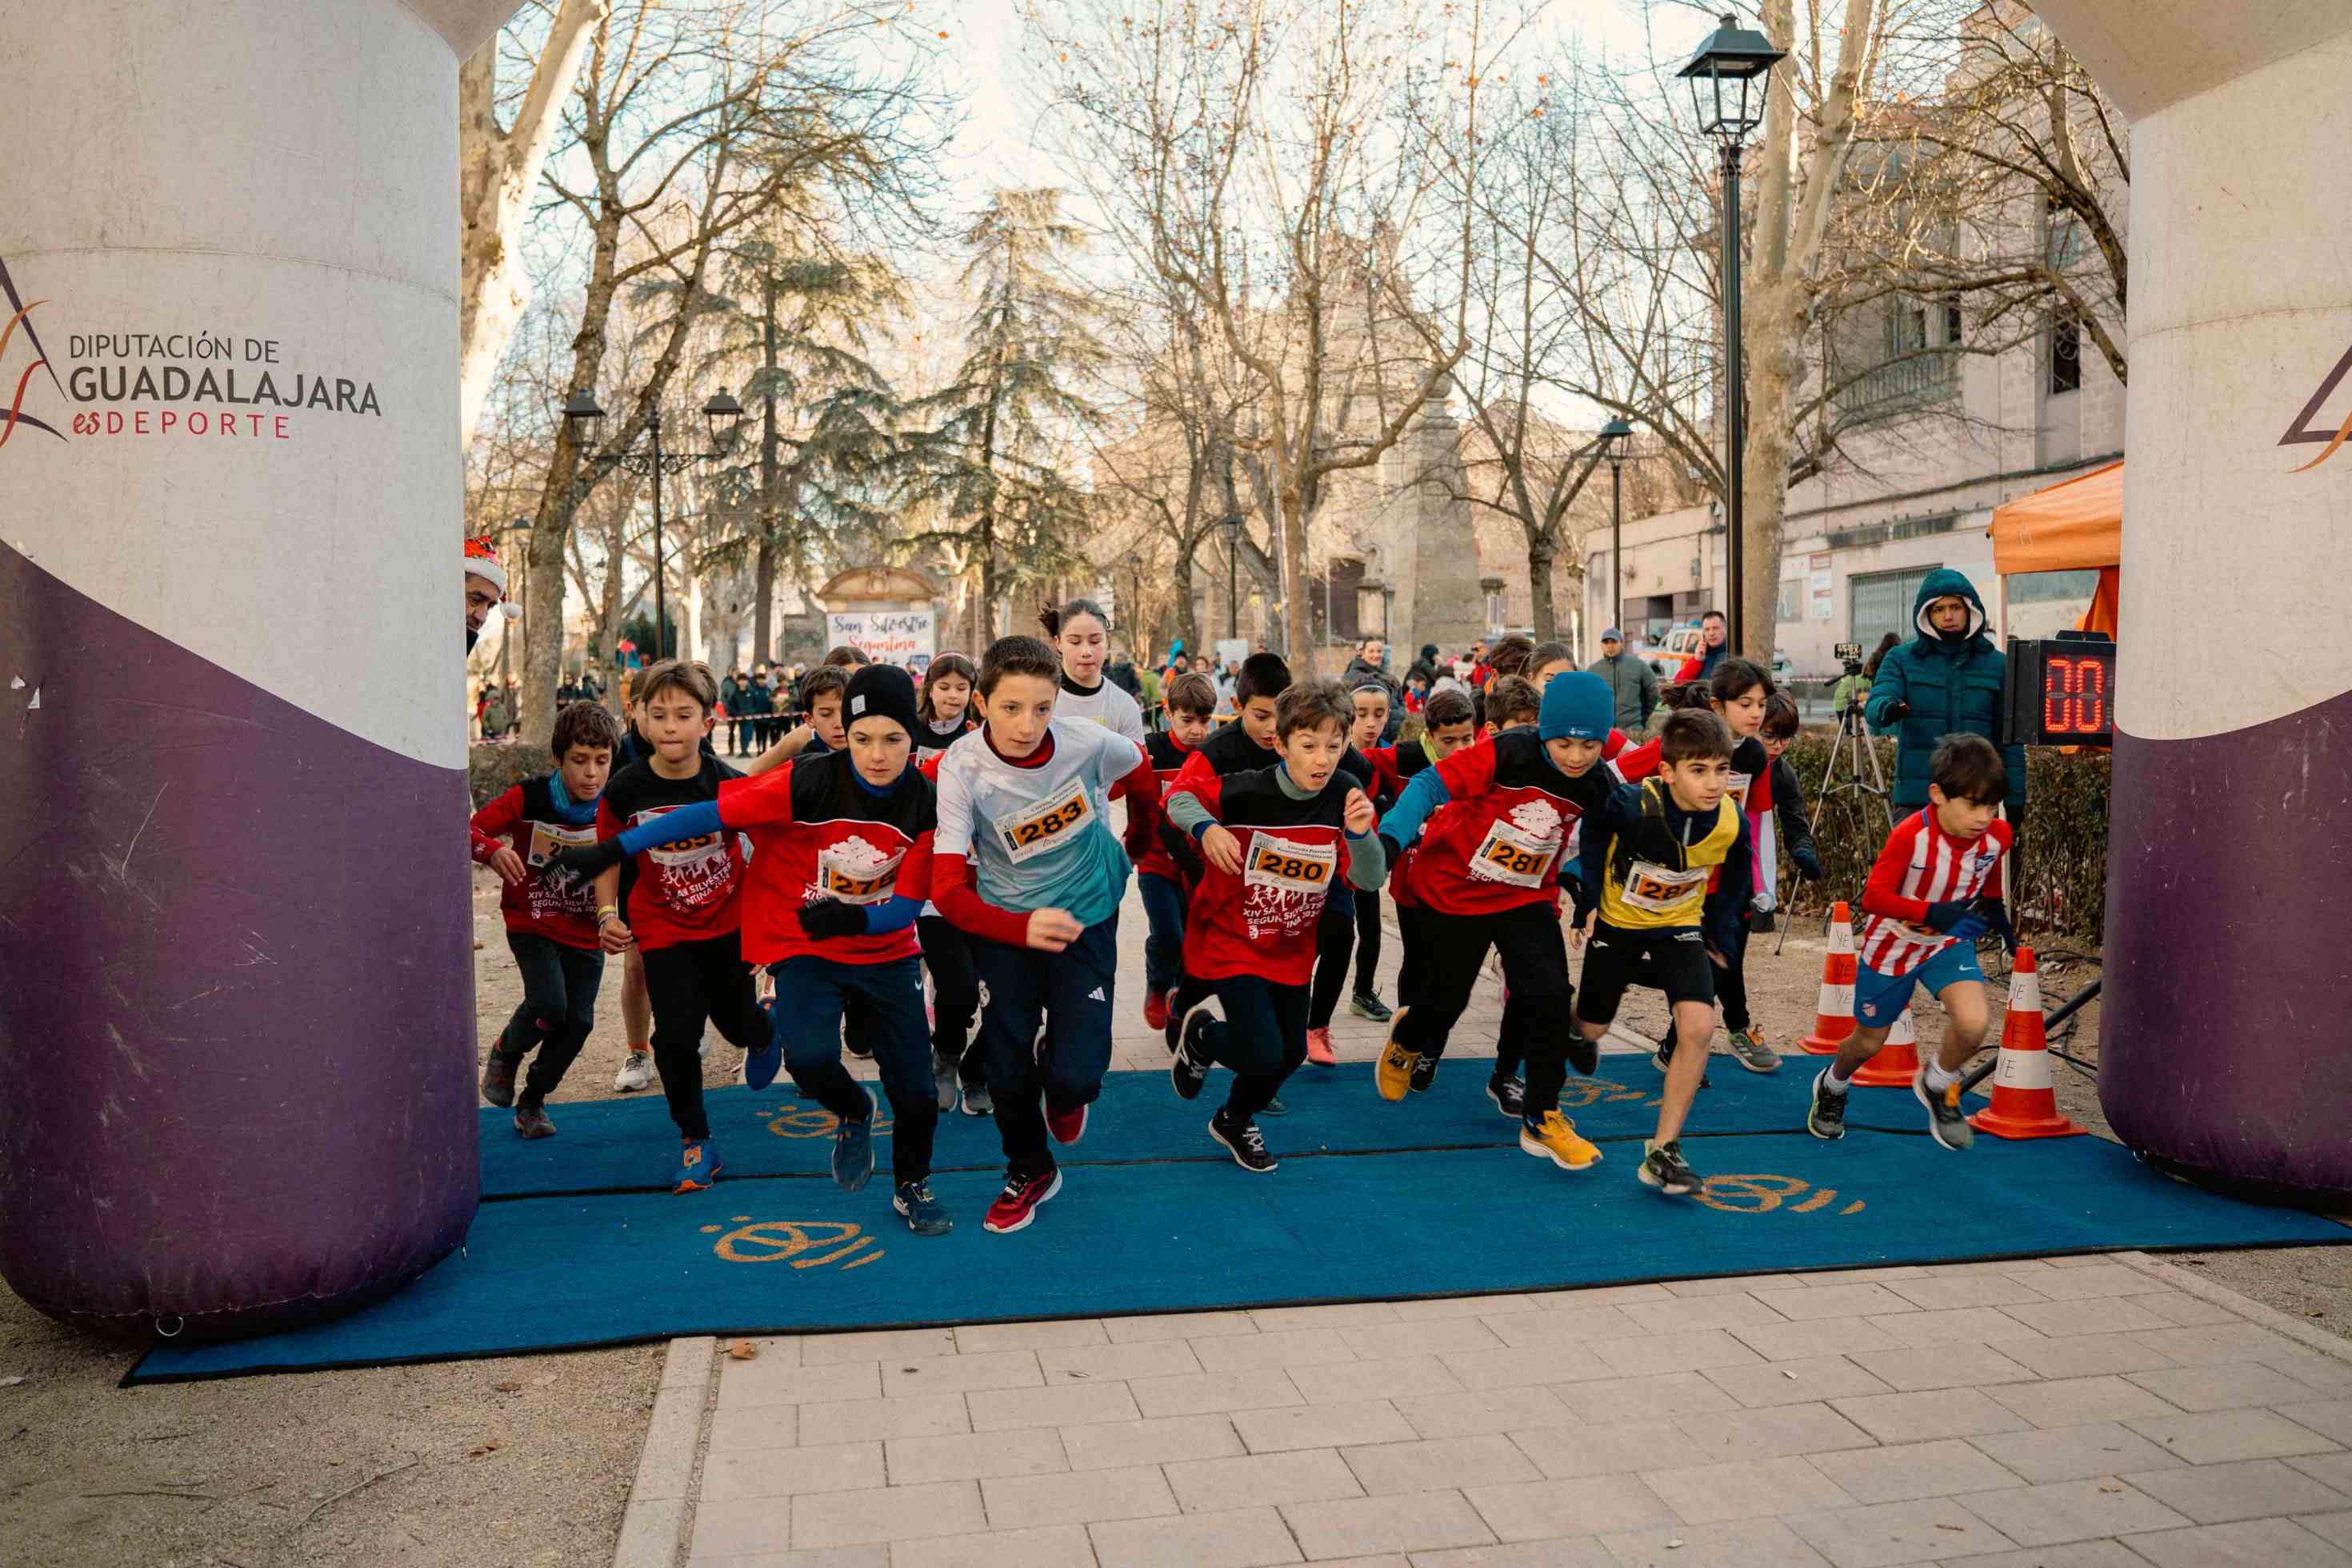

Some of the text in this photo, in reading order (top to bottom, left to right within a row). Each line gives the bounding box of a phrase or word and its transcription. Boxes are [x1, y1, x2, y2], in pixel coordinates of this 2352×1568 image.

[70, 330, 280, 363] DIPUTACIÓN DE
[70, 366, 382, 417] GUADALAJARA
[834, 614, 928, 634] San Silvestre
[1020, 801, 1082, 843] 283
[1262, 854, 1323, 880] 280
[1493, 845, 1543, 873] 281
[528, 890, 544, 900] XIV
[1242, 908, 1262, 918] XIV
